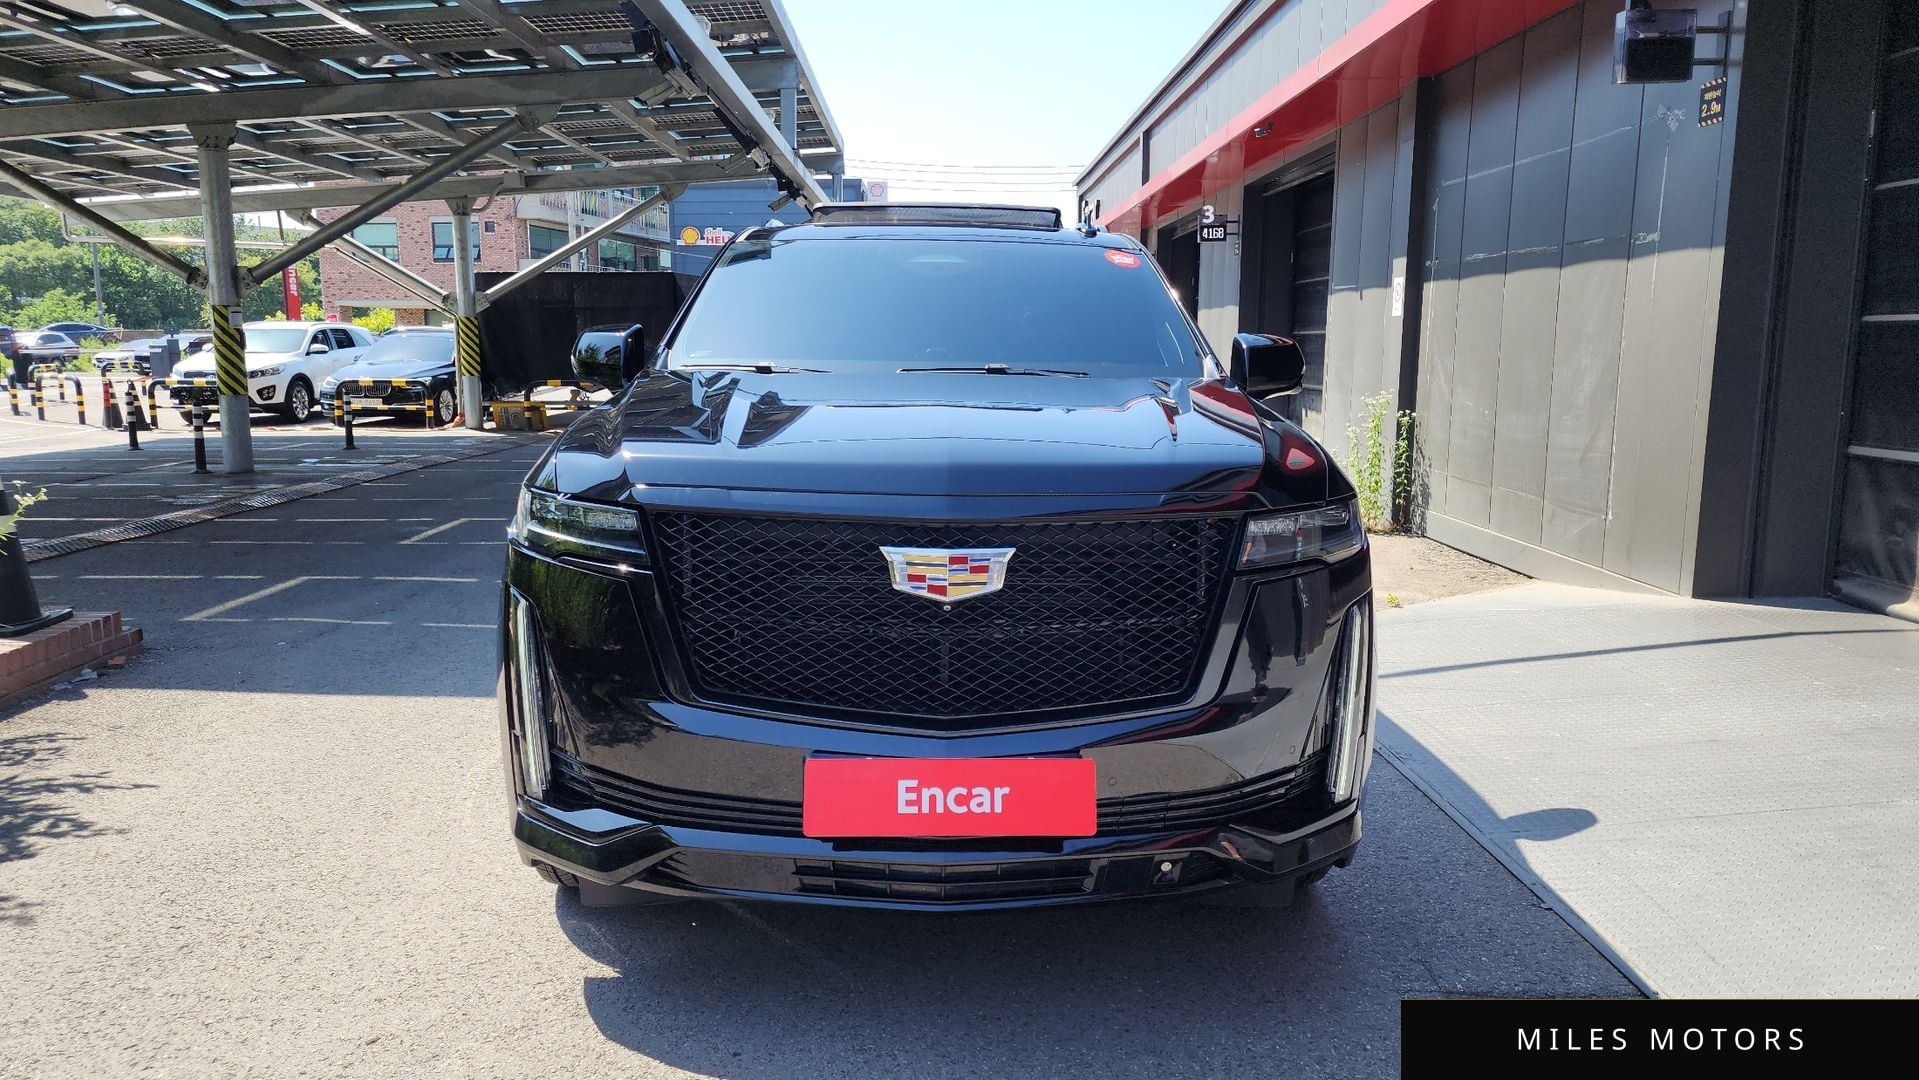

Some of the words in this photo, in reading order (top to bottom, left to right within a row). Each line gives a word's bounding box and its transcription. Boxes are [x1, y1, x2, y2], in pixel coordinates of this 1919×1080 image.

[1202, 204, 1215, 224] 3
[705, 228, 722, 236] Shell
[1202, 227, 1225, 239] 4168
[897, 779, 1011, 814] Encar
